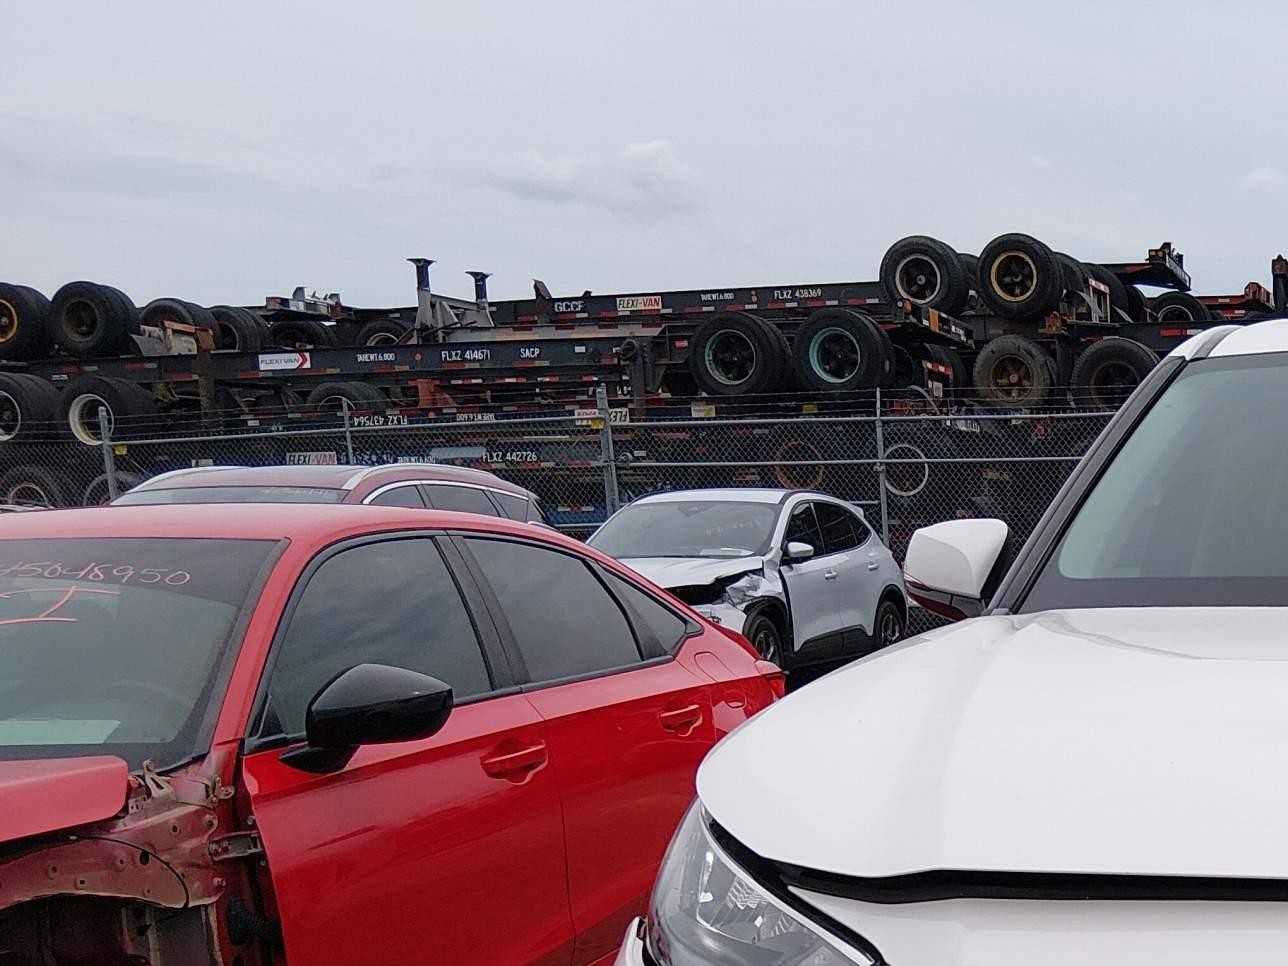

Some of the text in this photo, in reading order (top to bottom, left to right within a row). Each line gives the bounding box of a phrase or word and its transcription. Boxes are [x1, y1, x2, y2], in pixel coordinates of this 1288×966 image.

[774, 288, 822, 299] FLXZ 438369
[618, 298, 660, 309] FLEXI-VAN
[441, 349, 490, 361] FLXZ 414671
[520, 347, 540, 358] SACP
[353, 415, 408, 427] FLXZ 437564
[482, 451, 537, 462] FLXZ 442726
